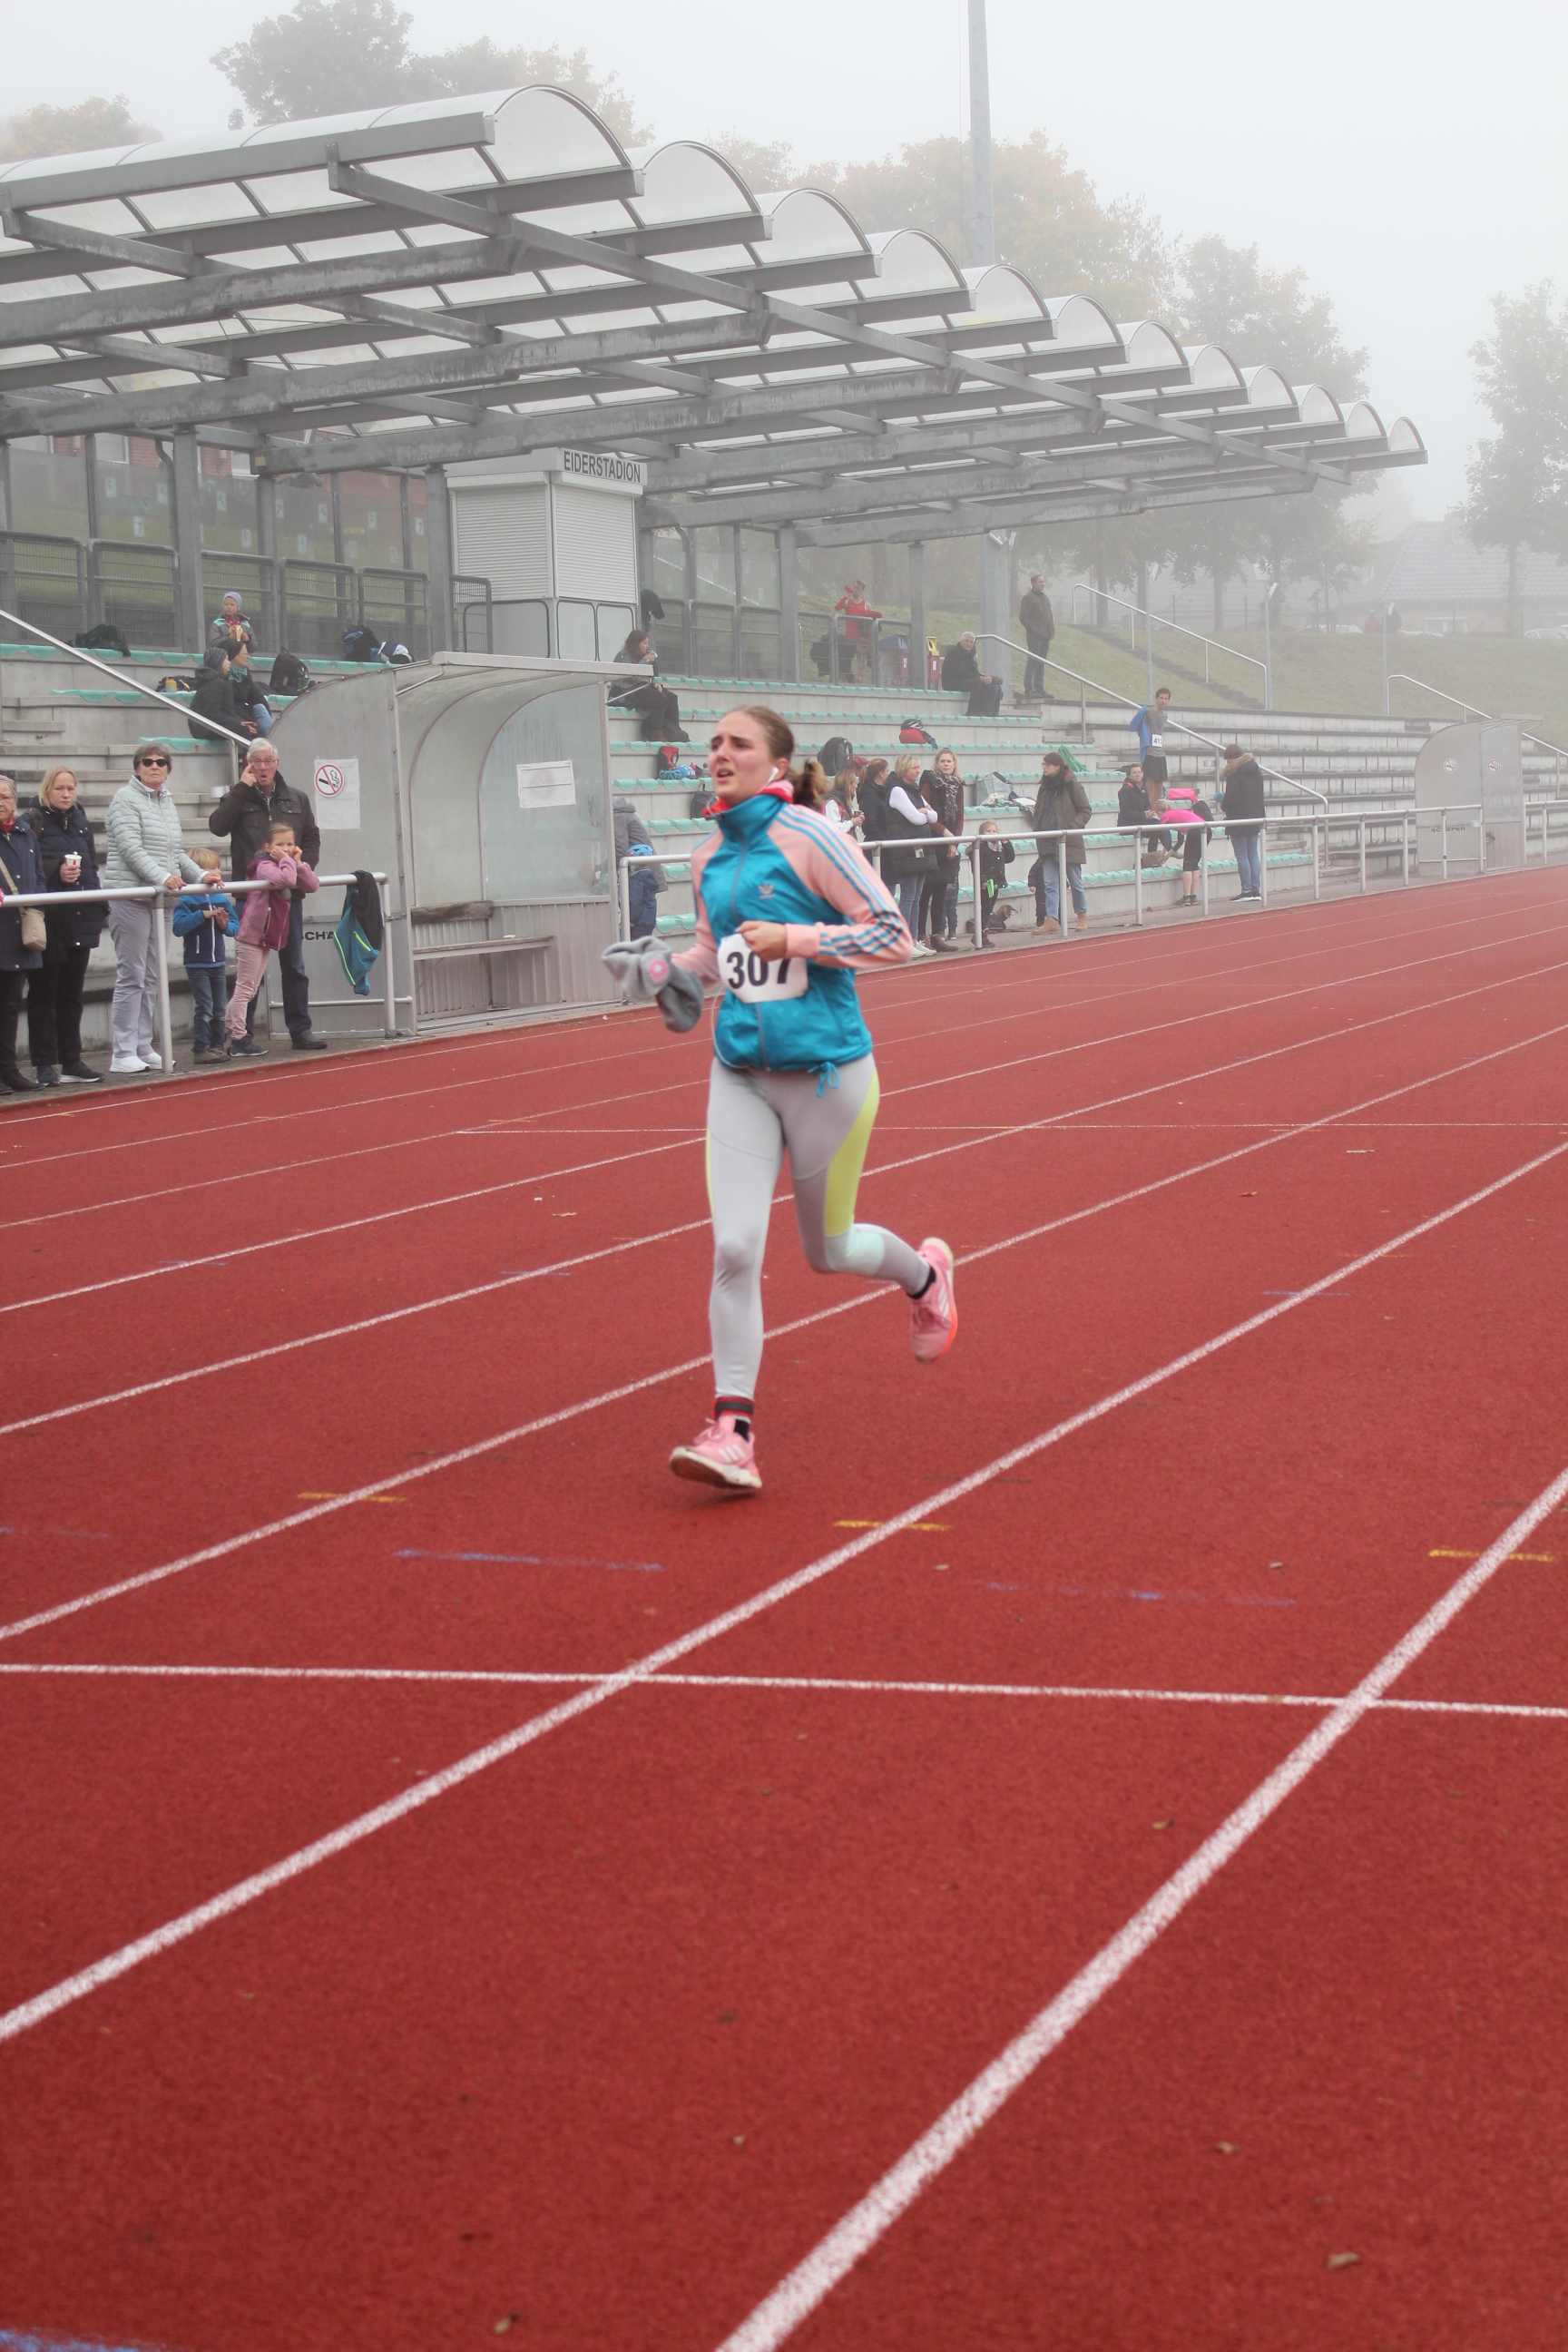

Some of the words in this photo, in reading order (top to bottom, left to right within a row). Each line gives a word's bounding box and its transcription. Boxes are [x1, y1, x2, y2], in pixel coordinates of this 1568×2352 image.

[564, 450, 641, 483] EIDERSTADION
[302, 931, 334, 940] CHA
[726, 951, 791, 989] 307
